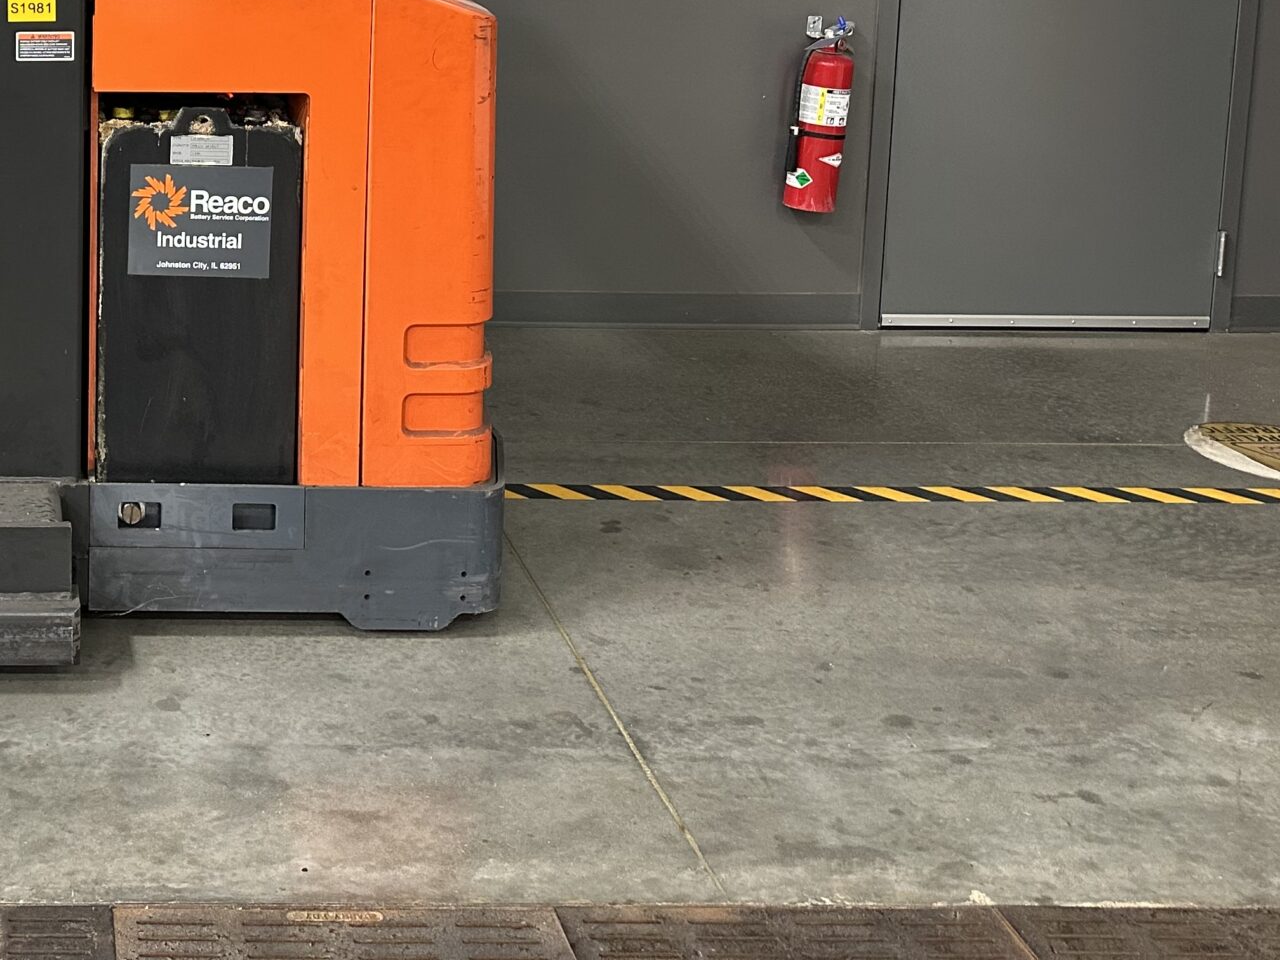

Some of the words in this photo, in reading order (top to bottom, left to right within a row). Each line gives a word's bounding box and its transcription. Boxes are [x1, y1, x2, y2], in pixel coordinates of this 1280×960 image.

[11, 3, 51, 13] S1981
[190, 190, 270, 214] Reaco
[157, 231, 242, 249] Industrial
[156, 261, 191, 269] Johnston
[192, 261, 210, 270] City,
[220, 262, 241, 270] 62951
